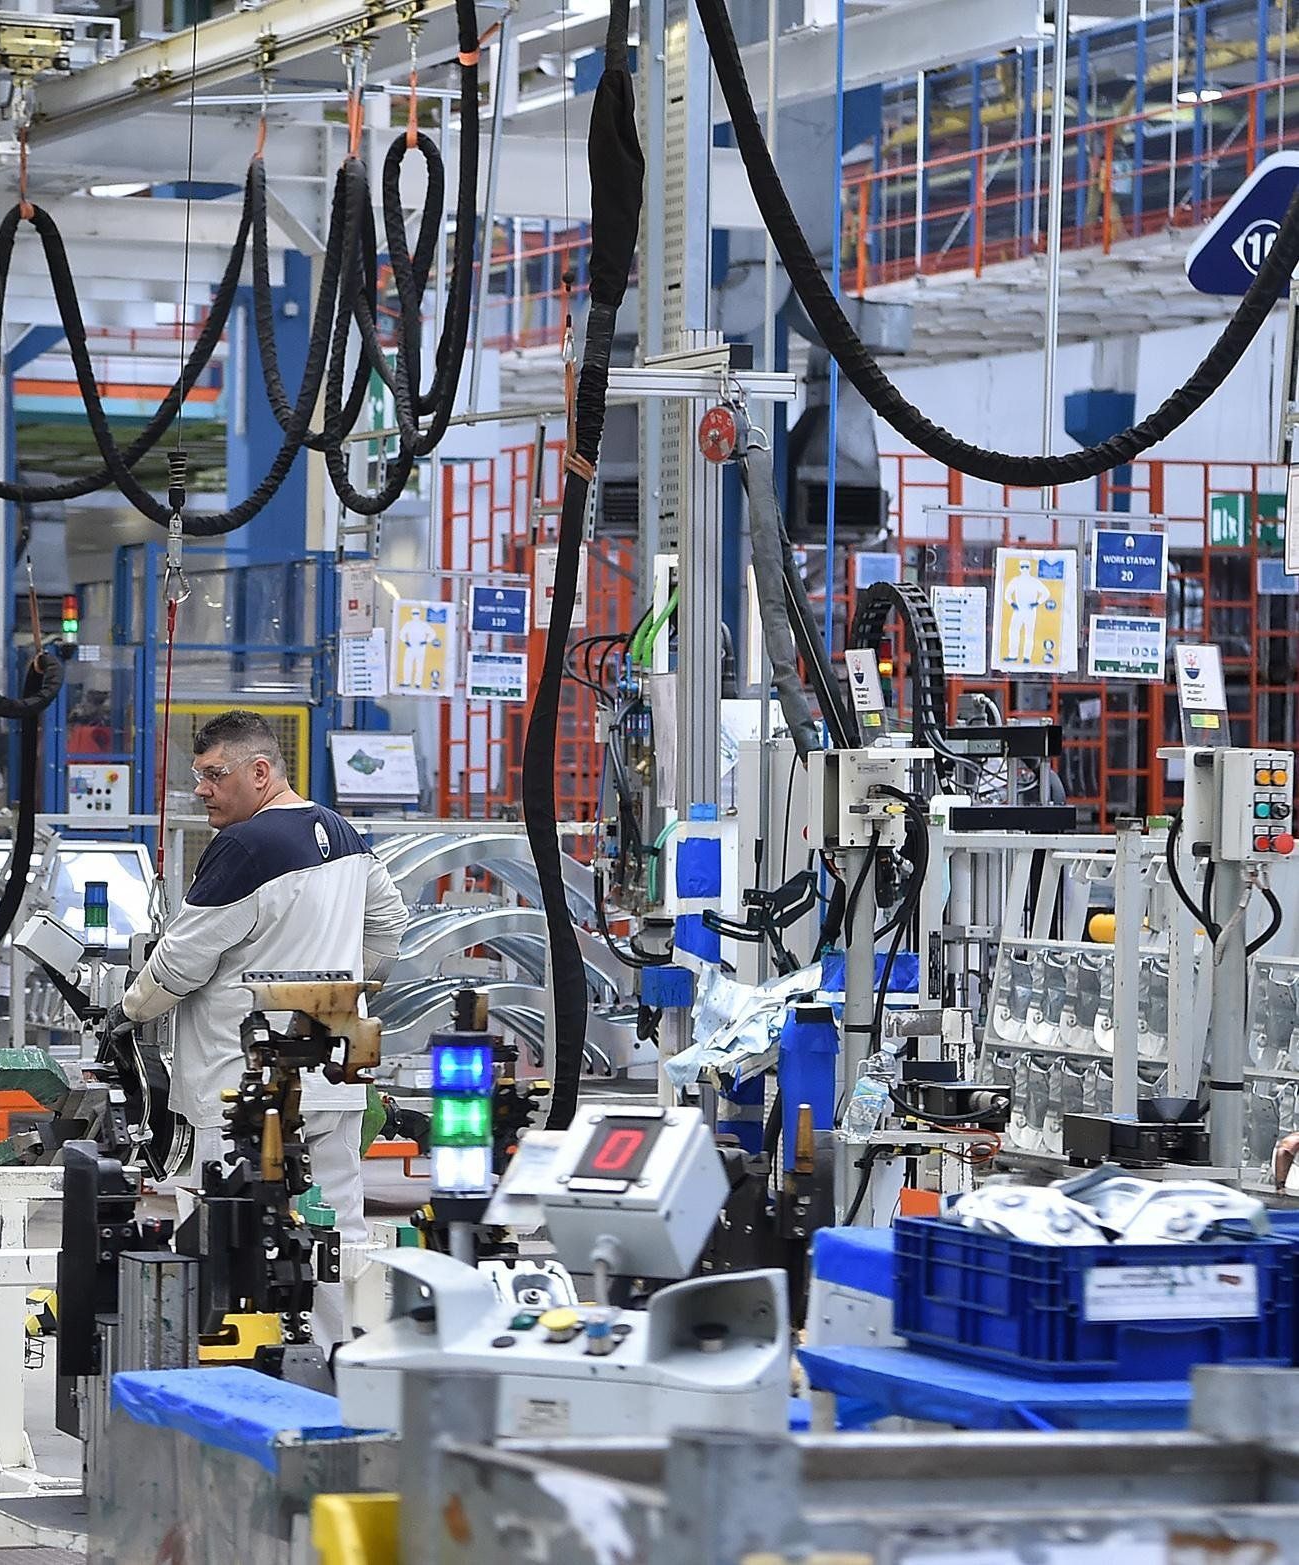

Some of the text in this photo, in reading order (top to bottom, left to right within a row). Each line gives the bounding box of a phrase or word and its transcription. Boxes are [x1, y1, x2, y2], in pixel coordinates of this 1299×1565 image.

[1103, 555, 1156, 566] WORK STATION
[1121, 570, 1134, 582] 20
[593, 1129, 646, 1170] 0
